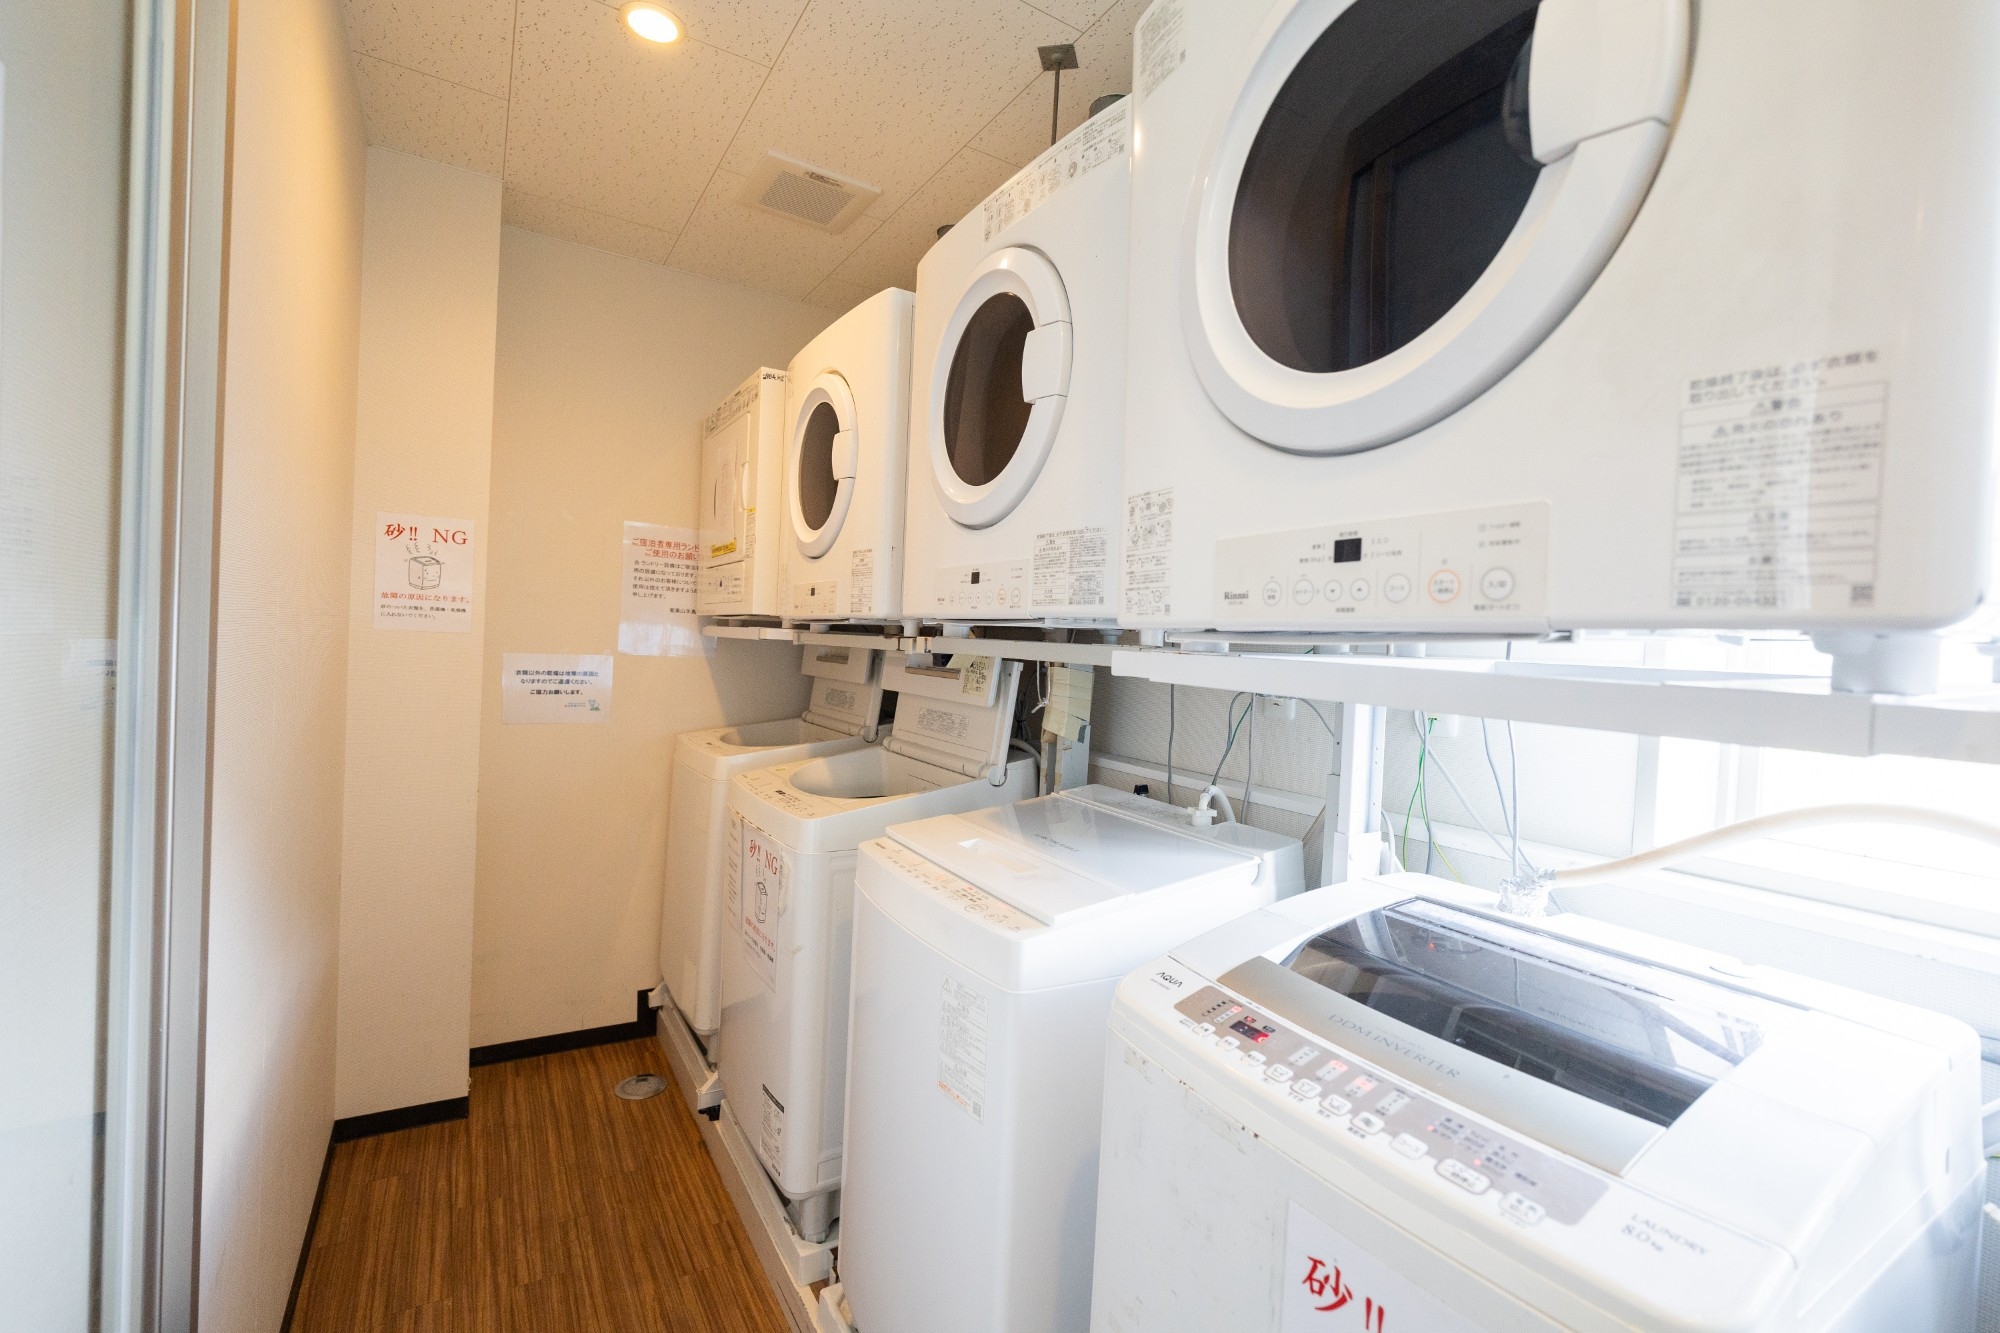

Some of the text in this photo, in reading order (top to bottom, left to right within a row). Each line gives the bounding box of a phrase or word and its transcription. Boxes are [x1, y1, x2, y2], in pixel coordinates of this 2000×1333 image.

[384, 523, 468, 545] 砂!! NG
[381, 591, 470, 604] 故障の原因になります。
[1224, 590, 1249, 600] Rinnai
[515, 669, 599, 677] 衣類以外の乾燥は故障の原因と
[765, 850, 778, 875] NG
[1156, 971, 1183, 988] AQUA
[1373, 1035, 1460, 1078] INVERTER
